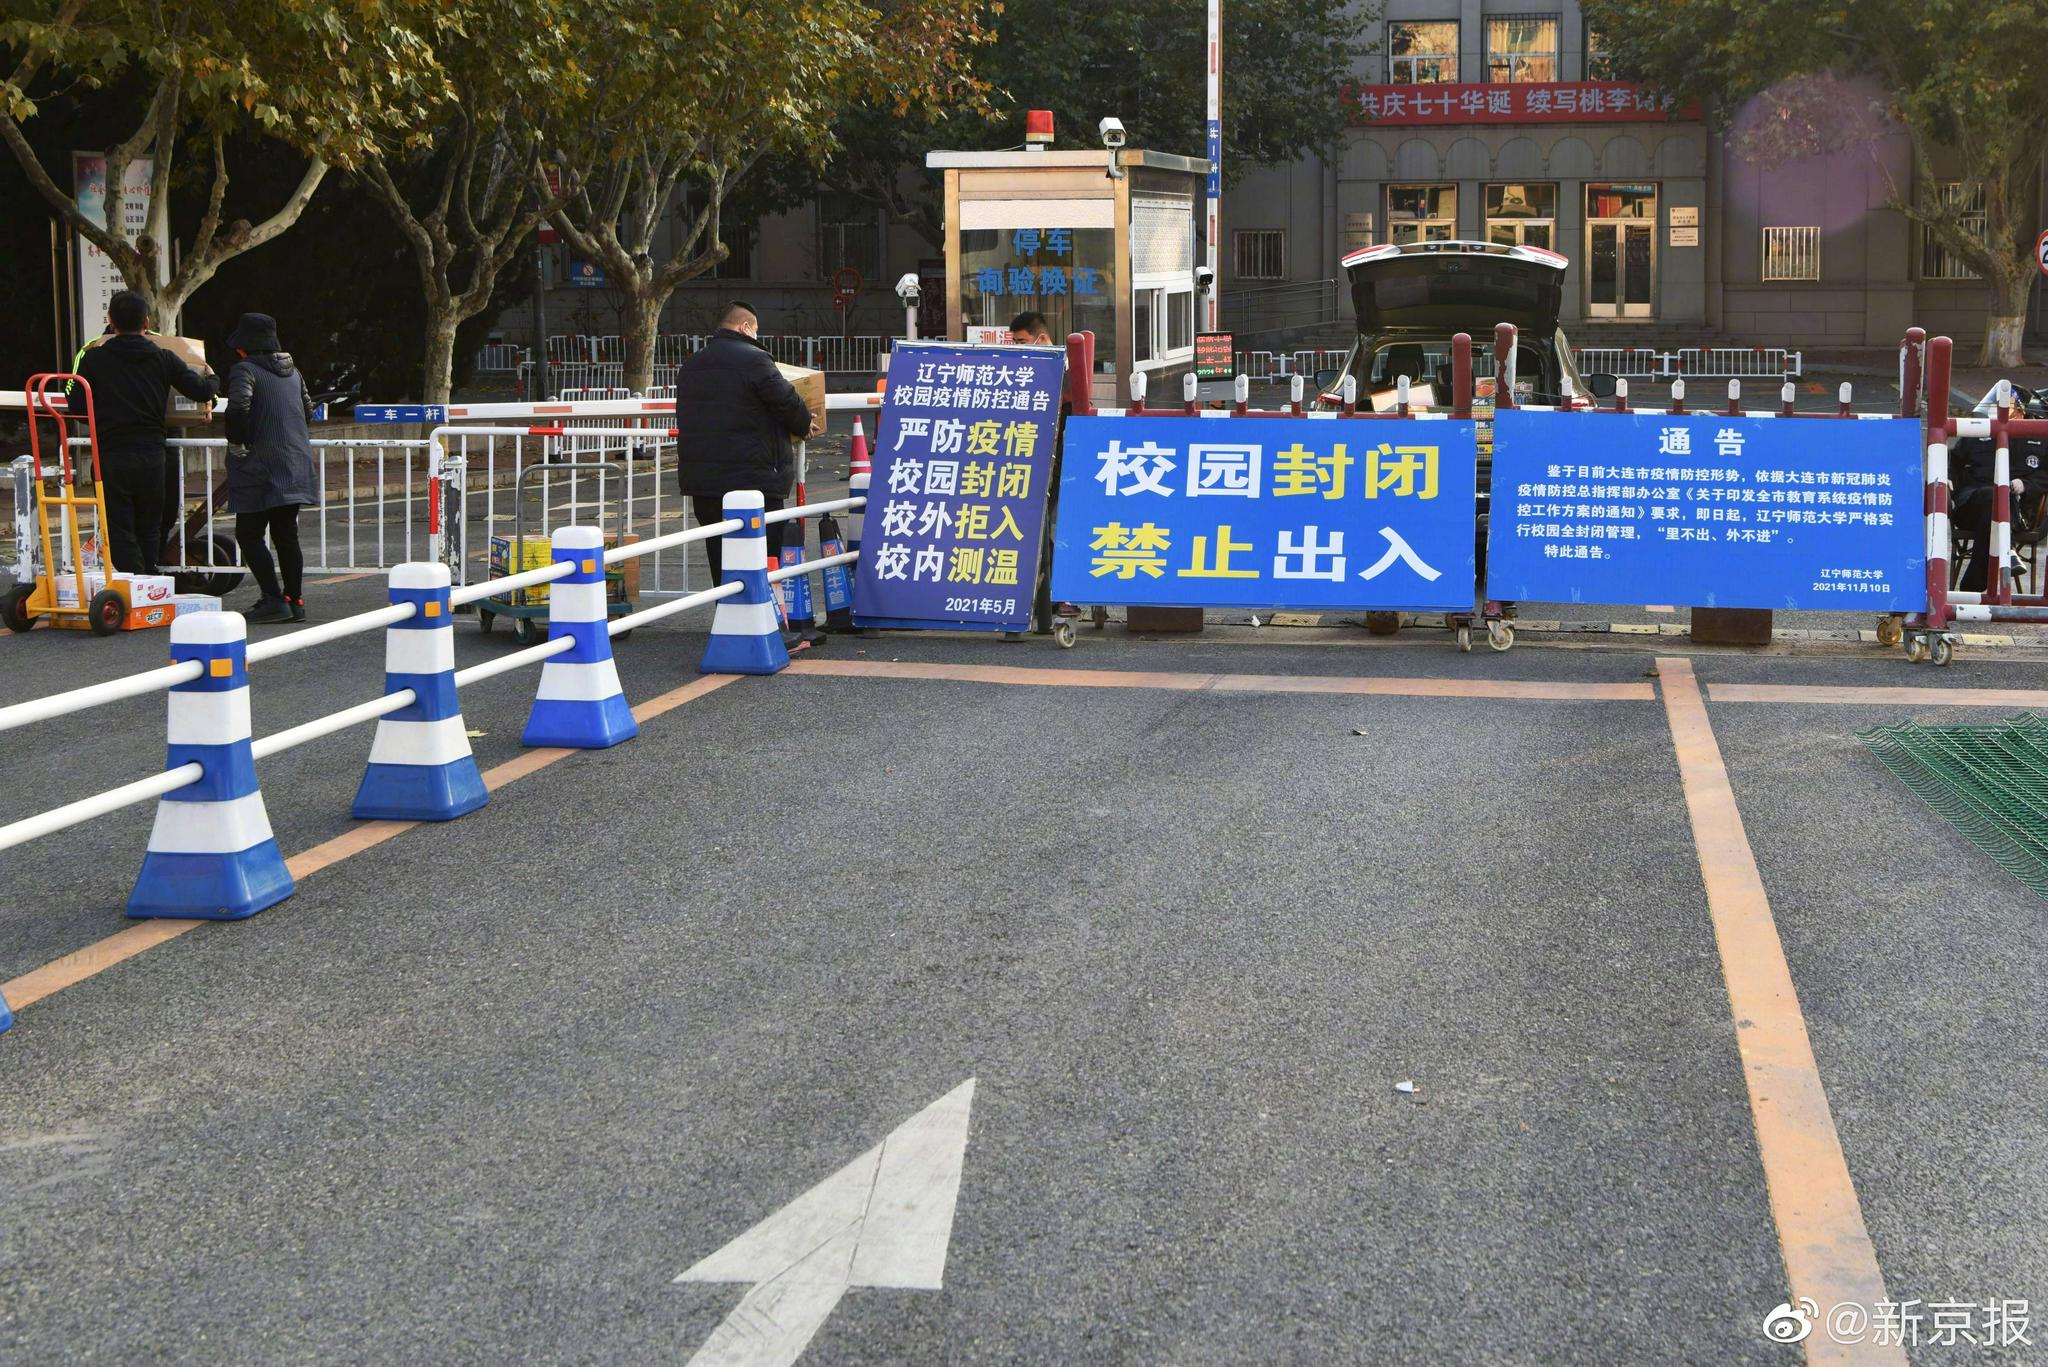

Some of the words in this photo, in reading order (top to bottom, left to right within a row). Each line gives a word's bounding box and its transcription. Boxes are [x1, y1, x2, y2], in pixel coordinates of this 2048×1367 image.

[1357, 90, 1511, 118] 共庆七十华诞
[1012, 228, 1073, 257] 停车
[976, 266, 1101, 296] 询验换证
[916, 363, 1035, 388] 辽宁师范大学
[892, 384, 1050, 412] 校园疫情防控通告
[363, 408, 440, 421] 一车一杆
[893, 417, 1039, 457] 严防疫情
[888, 457, 1033, 499] 校园封闭
[1095, 440, 1440, 500] 校园封闭
[881, 499, 1025, 542] 校外拒入
[874, 542, 1019, 585] 校内测温
[1088, 521, 1443, 582] 禁止出入
[1544, 545, 1611, 560] 特此通告。
[1812, 582, 1891, 594] 2021年11月10日
[1820, 568, 1884, 580] 辽宁师范大学
[945, 597, 1016, 616] 2021年5月
